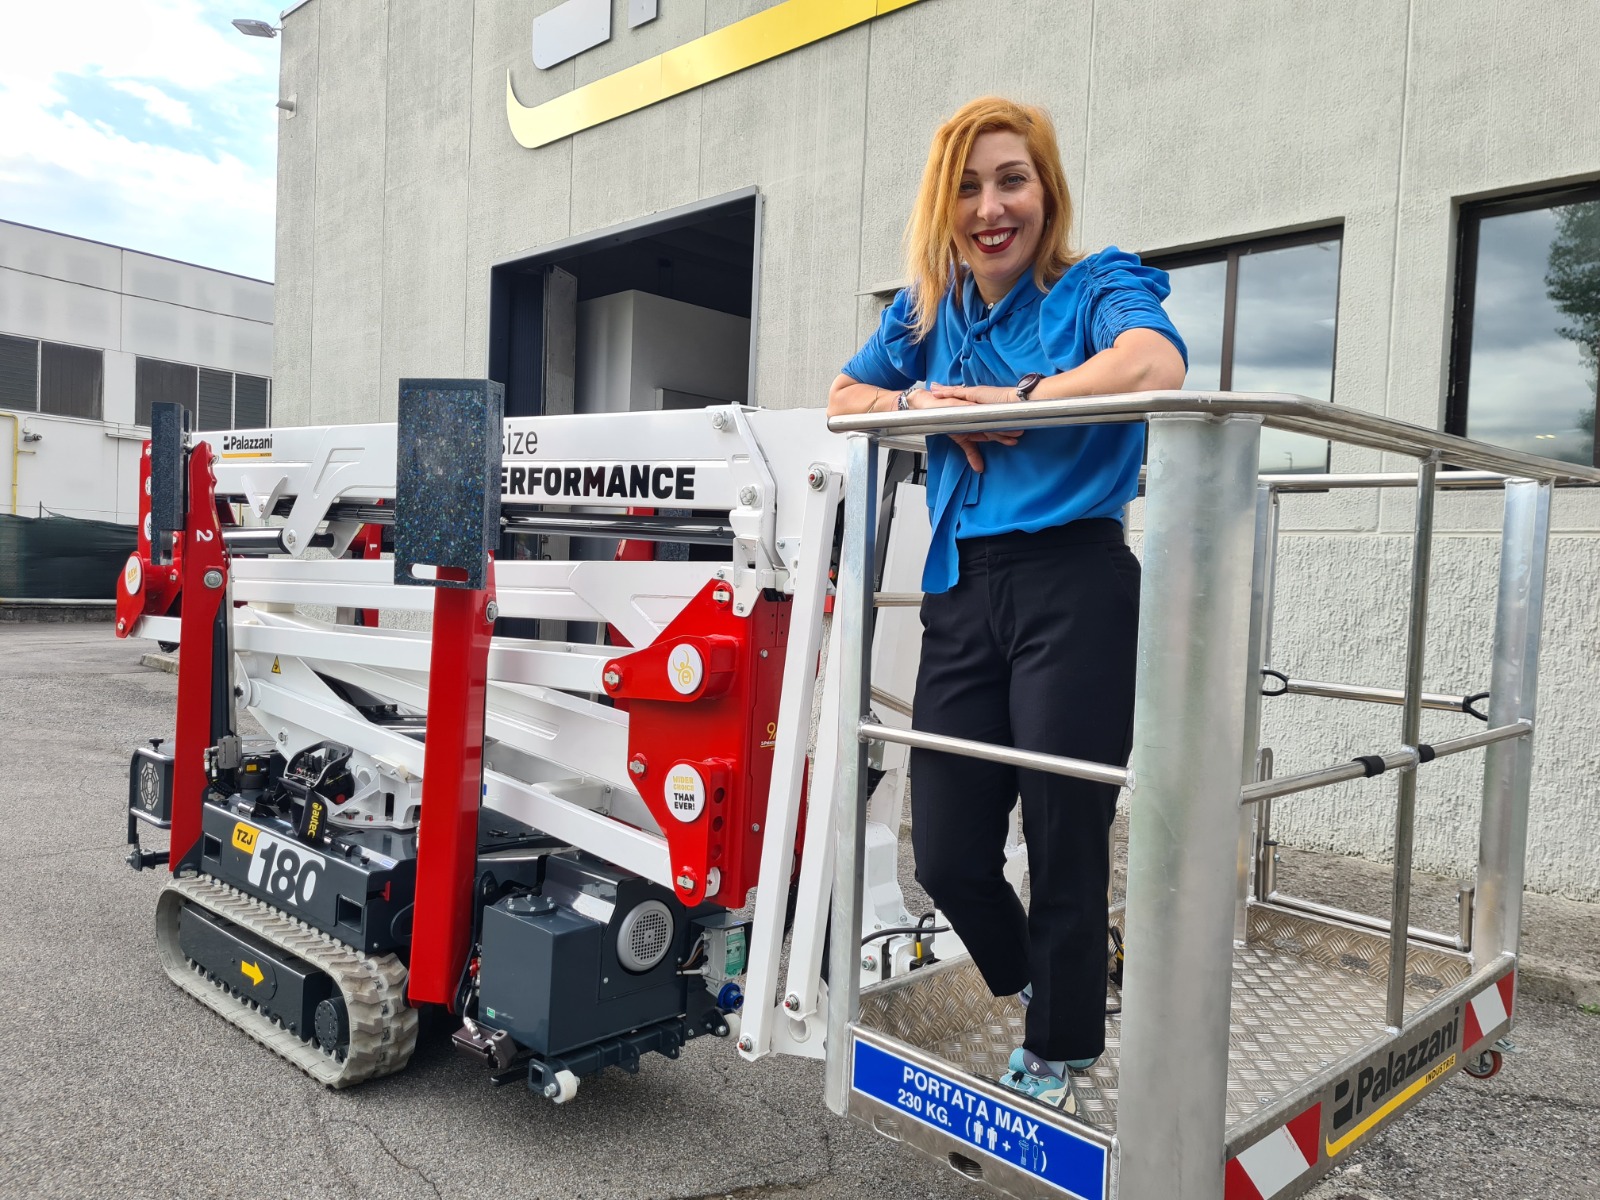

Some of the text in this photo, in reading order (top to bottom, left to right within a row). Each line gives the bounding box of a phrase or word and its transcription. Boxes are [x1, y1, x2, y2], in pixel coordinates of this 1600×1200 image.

[231, 433, 272, 450] Palazzani
[197, 529, 213, 542] 2
[673, 776, 694, 784] WIDER
[673, 783, 695, 791] CHOICE
[674, 793, 695, 802] THAN
[674, 801, 696, 811] EVER!
[307, 810, 320, 839] autec
[237, 828, 254, 846] TZJ
[260, 841, 325, 908] 180
[1355, 1006, 1460, 1116] Palazzani
[1425, 1055, 1455, 1084] INDUSTRIE
[897, 1088, 953, 1127] 230 KG.
[903, 1066, 1045, 1147] PORTATA MAX.
